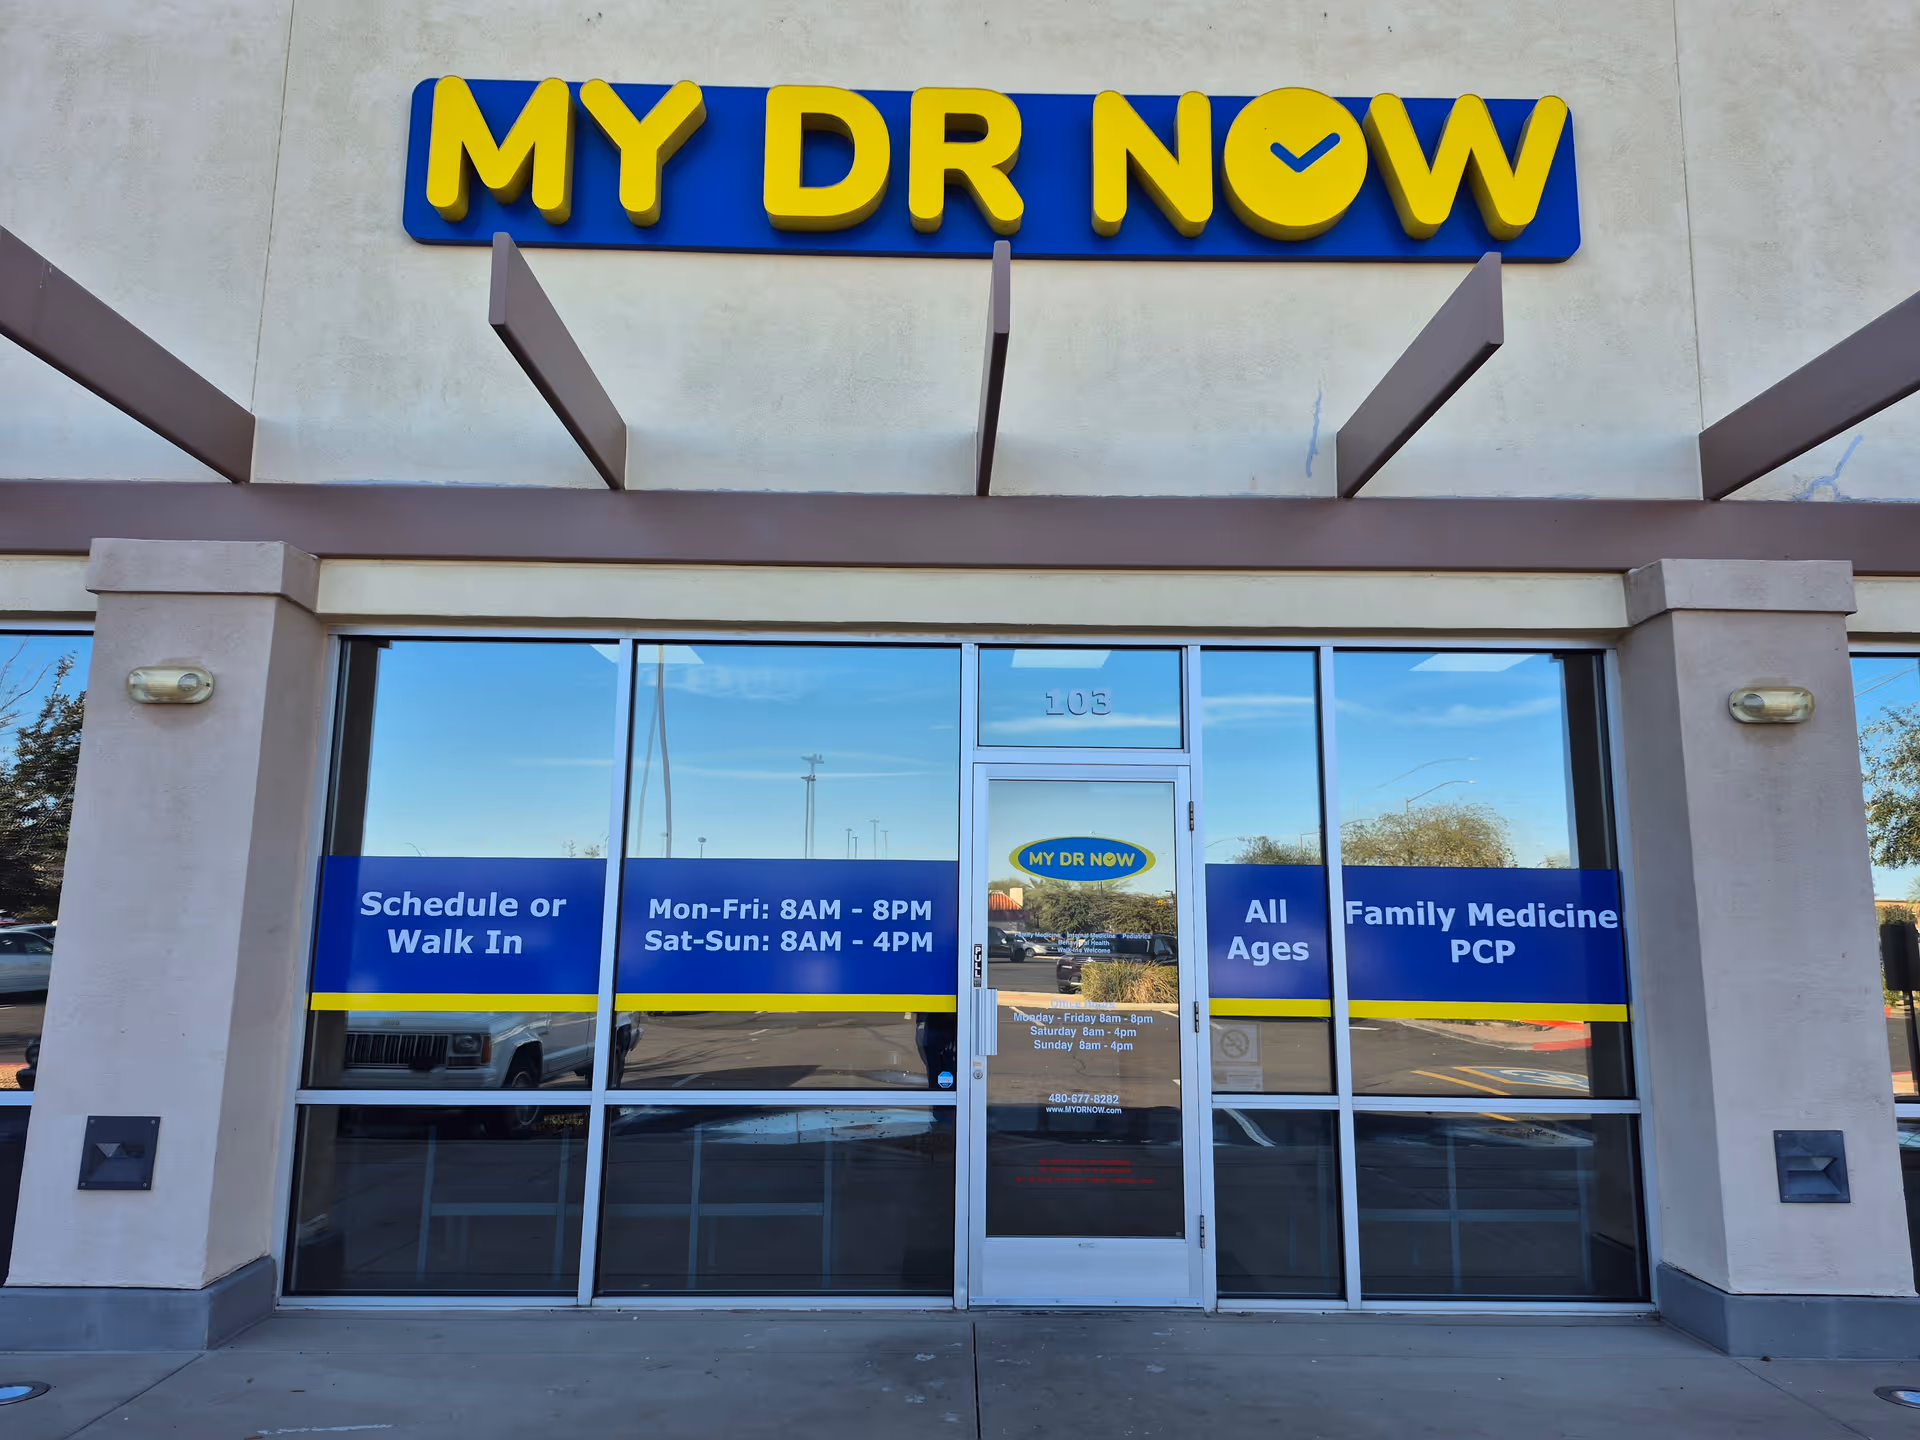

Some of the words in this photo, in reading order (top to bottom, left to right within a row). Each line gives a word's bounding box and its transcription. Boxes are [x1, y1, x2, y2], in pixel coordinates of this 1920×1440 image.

[426, 75, 707, 227] MY
[763, 84, 1023, 236] DR
[1091, 87, 1568, 241] NOW
[1045, 687, 1112, 716] 103
[1028, 852, 1055, 866] MY
[1060, 852, 1085, 866] DR
[1090, 852, 1136, 867] NOW
[361, 892, 517, 917] Schedule
[530, 899, 567, 917] or
[649, 899, 769, 920] Mon-Fri:
[780, 899, 840, 920] 8AM
[873, 900, 932, 921] 8PM
[1245, 899, 1287, 924] All
[1346, 900, 1456, 932] Family
[1468, 902, 1618, 929] Medicine
[387, 929, 473, 954] Walk
[485, 931, 522, 954] In
[645, 930, 769, 951] Sat-Sun:
[780, 931, 841, 952] 8AM
[873, 932, 933, 952] 4PM
[1122, 932, 1152, 940] Pediatrics
[974, 946, 982, 978] PULL
[1227, 936, 1309, 967] Ages
[1451, 939, 1516, 964] PCP
[1051, 1000, 1081, 1009] Office
[1084, 1000, 1116, 1009] Hours
[1013, 1012, 1055, 1024] Monday
[1064, 1012, 1096, 1024] Friday
[1099, 1014, 1121, 1023] 8am
[1131, 1014, 1154, 1025] 8pm
[1030, 1026, 1077, 1038] Saturday
[1082, 1026, 1105, 1036] 8am
[1114, 1027, 1137, 1038] 4pm
[1034, 1040, 1073, 1051] Sunday
[1079, 1040, 1101, 1050] 8am
[1110, 1041, 1133, 1052] 4pm
[1046, 1105, 1122, 1114] www.MYDRNOW.com
[1048, 1093, 1119, 1105] 480-677-8282
